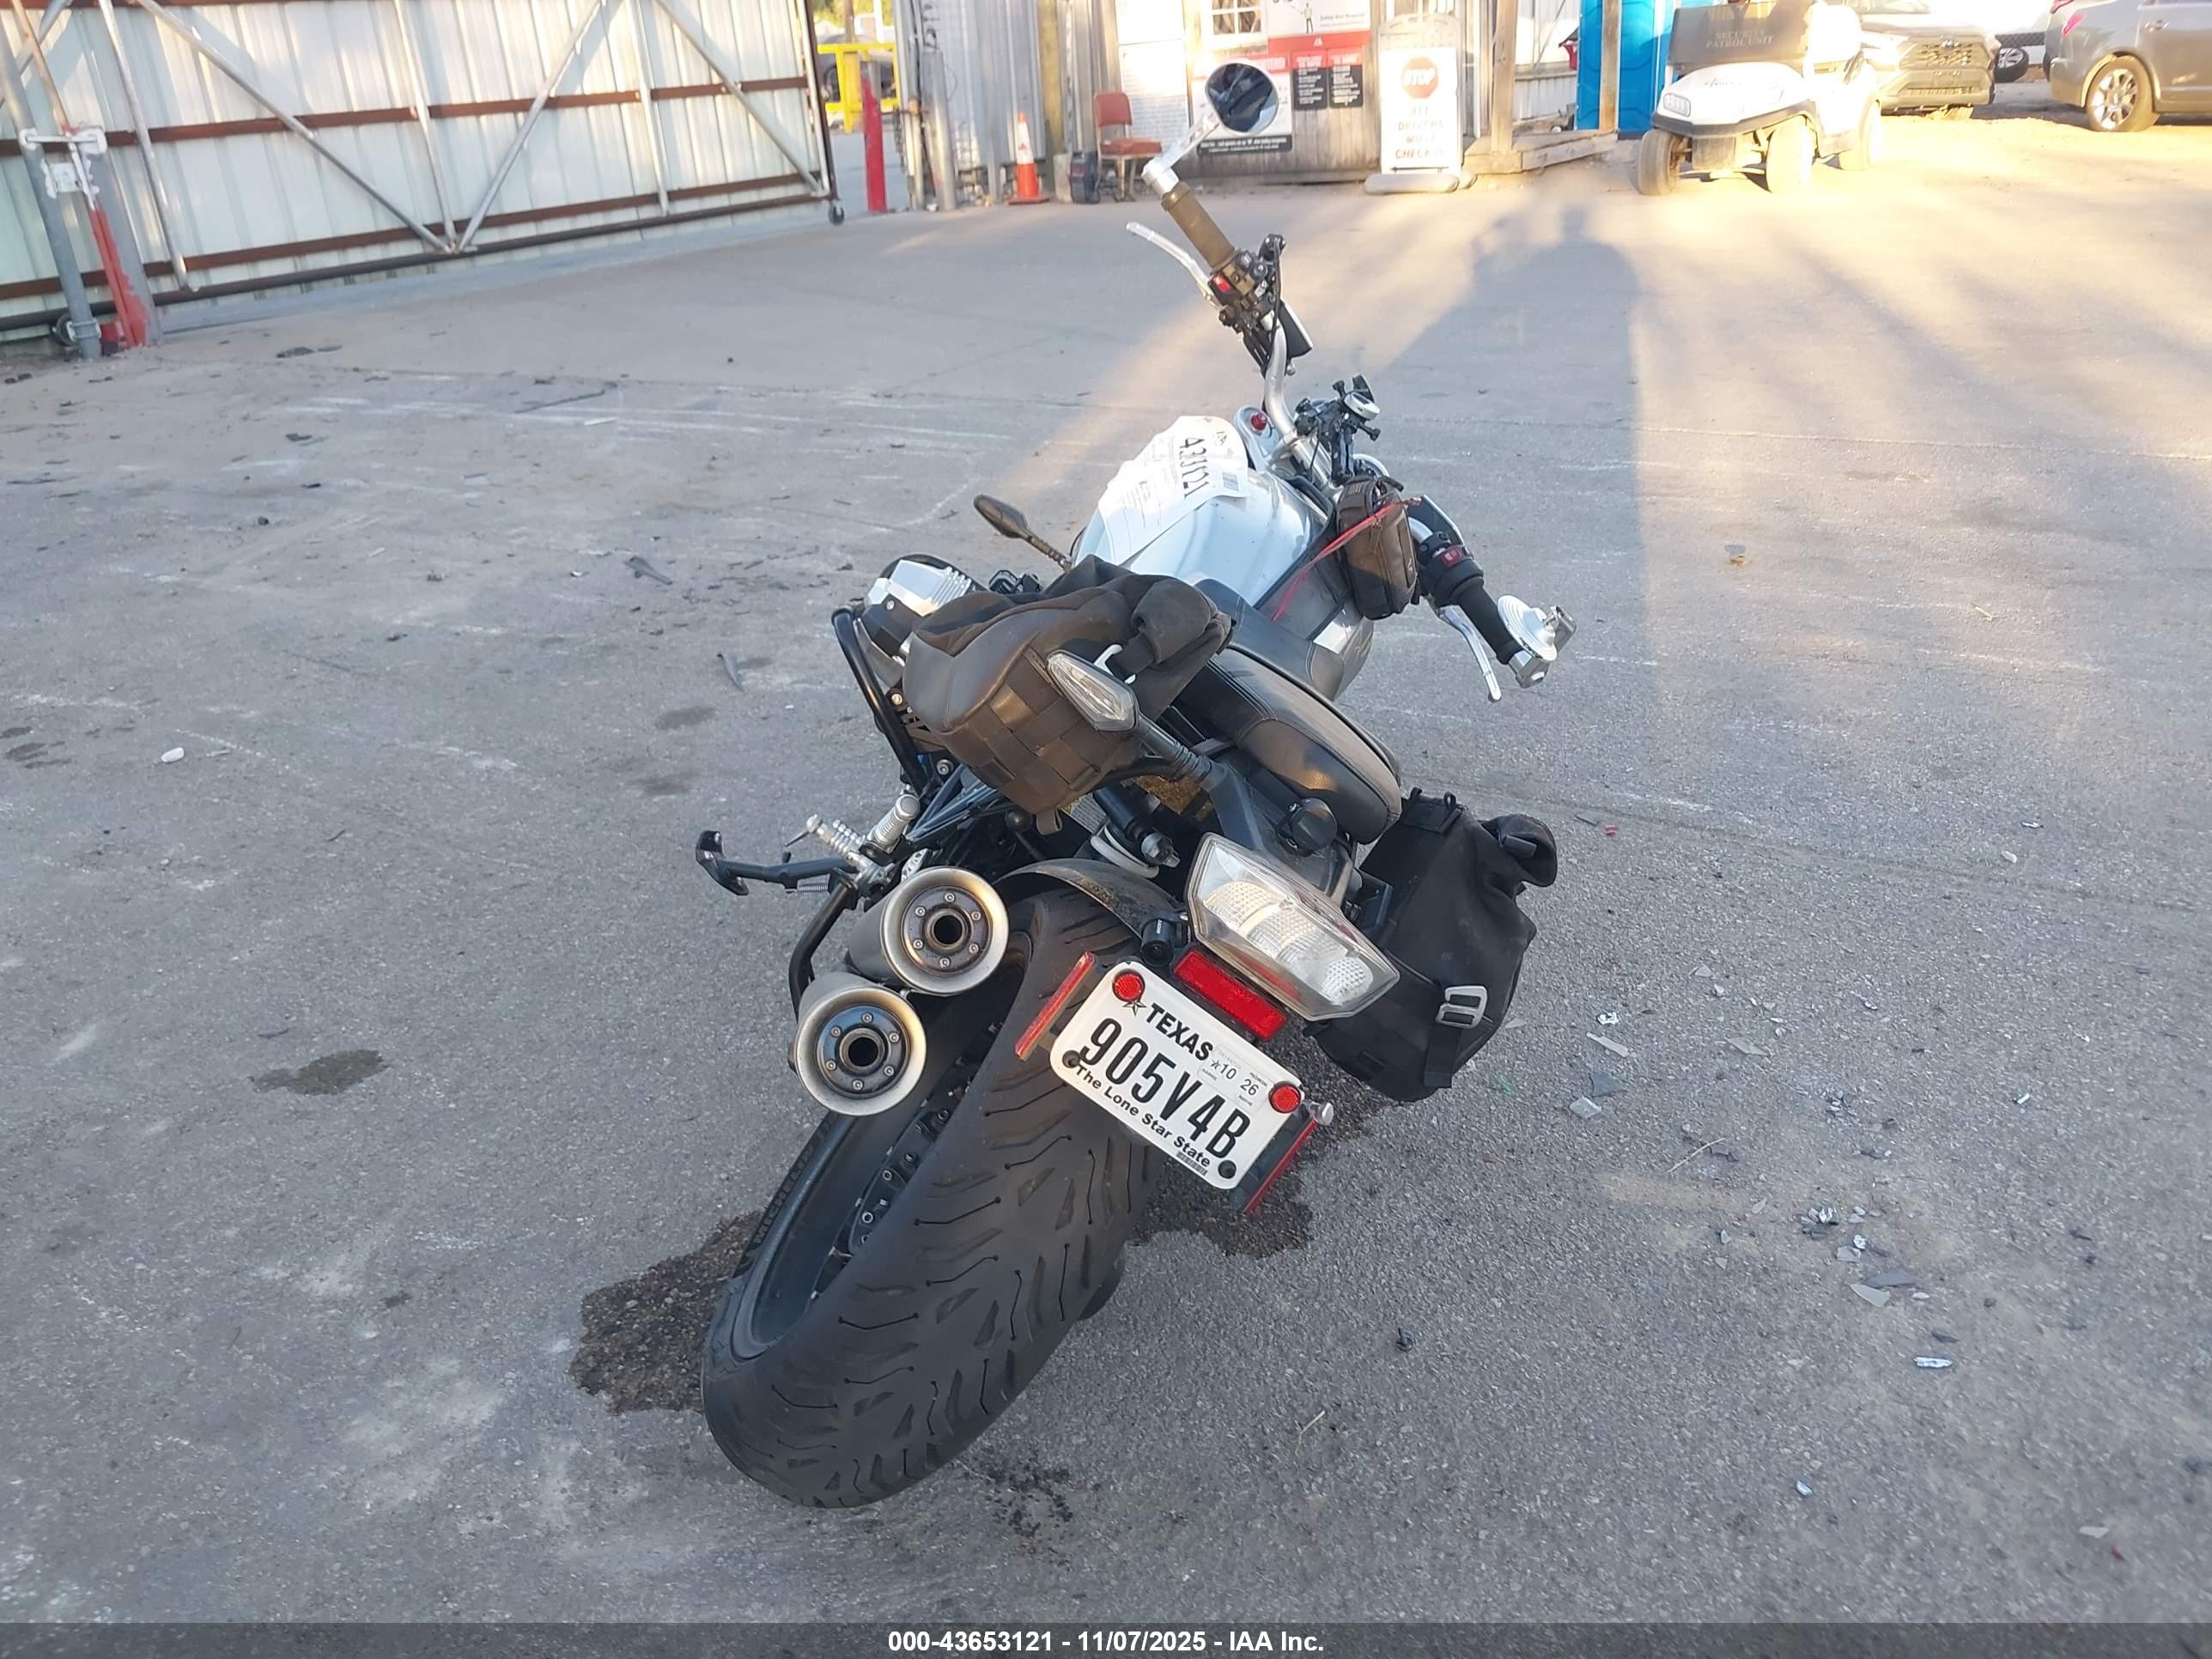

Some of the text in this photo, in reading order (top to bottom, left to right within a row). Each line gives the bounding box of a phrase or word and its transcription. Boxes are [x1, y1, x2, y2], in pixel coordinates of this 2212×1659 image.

[1705, 35, 1775, 49] PATROL UNIT
[1716, 28, 1765, 40] SECURITY
[1402, 68, 1437, 86] STOP
[1398, 118, 1443, 131] DRIVERS
[1395, 148, 1430, 160] CHECK
[1146, 1003, 1213, 1060] TEXAS
[1079, 1018, 1250, 1158] 905V4B
[1220, 1062, 1237, 1080] 10
[1240, 1079, 1260, 1096] 26
[1075, 1064, 1102, 1090] The
[1103, 1086, 1139, 1116] Lone
[1141, 1113, 1173, 1139] Star
[1174, 1136, 1211, 1168] State
[753, 1144, 815, 1245] MICHELIN
